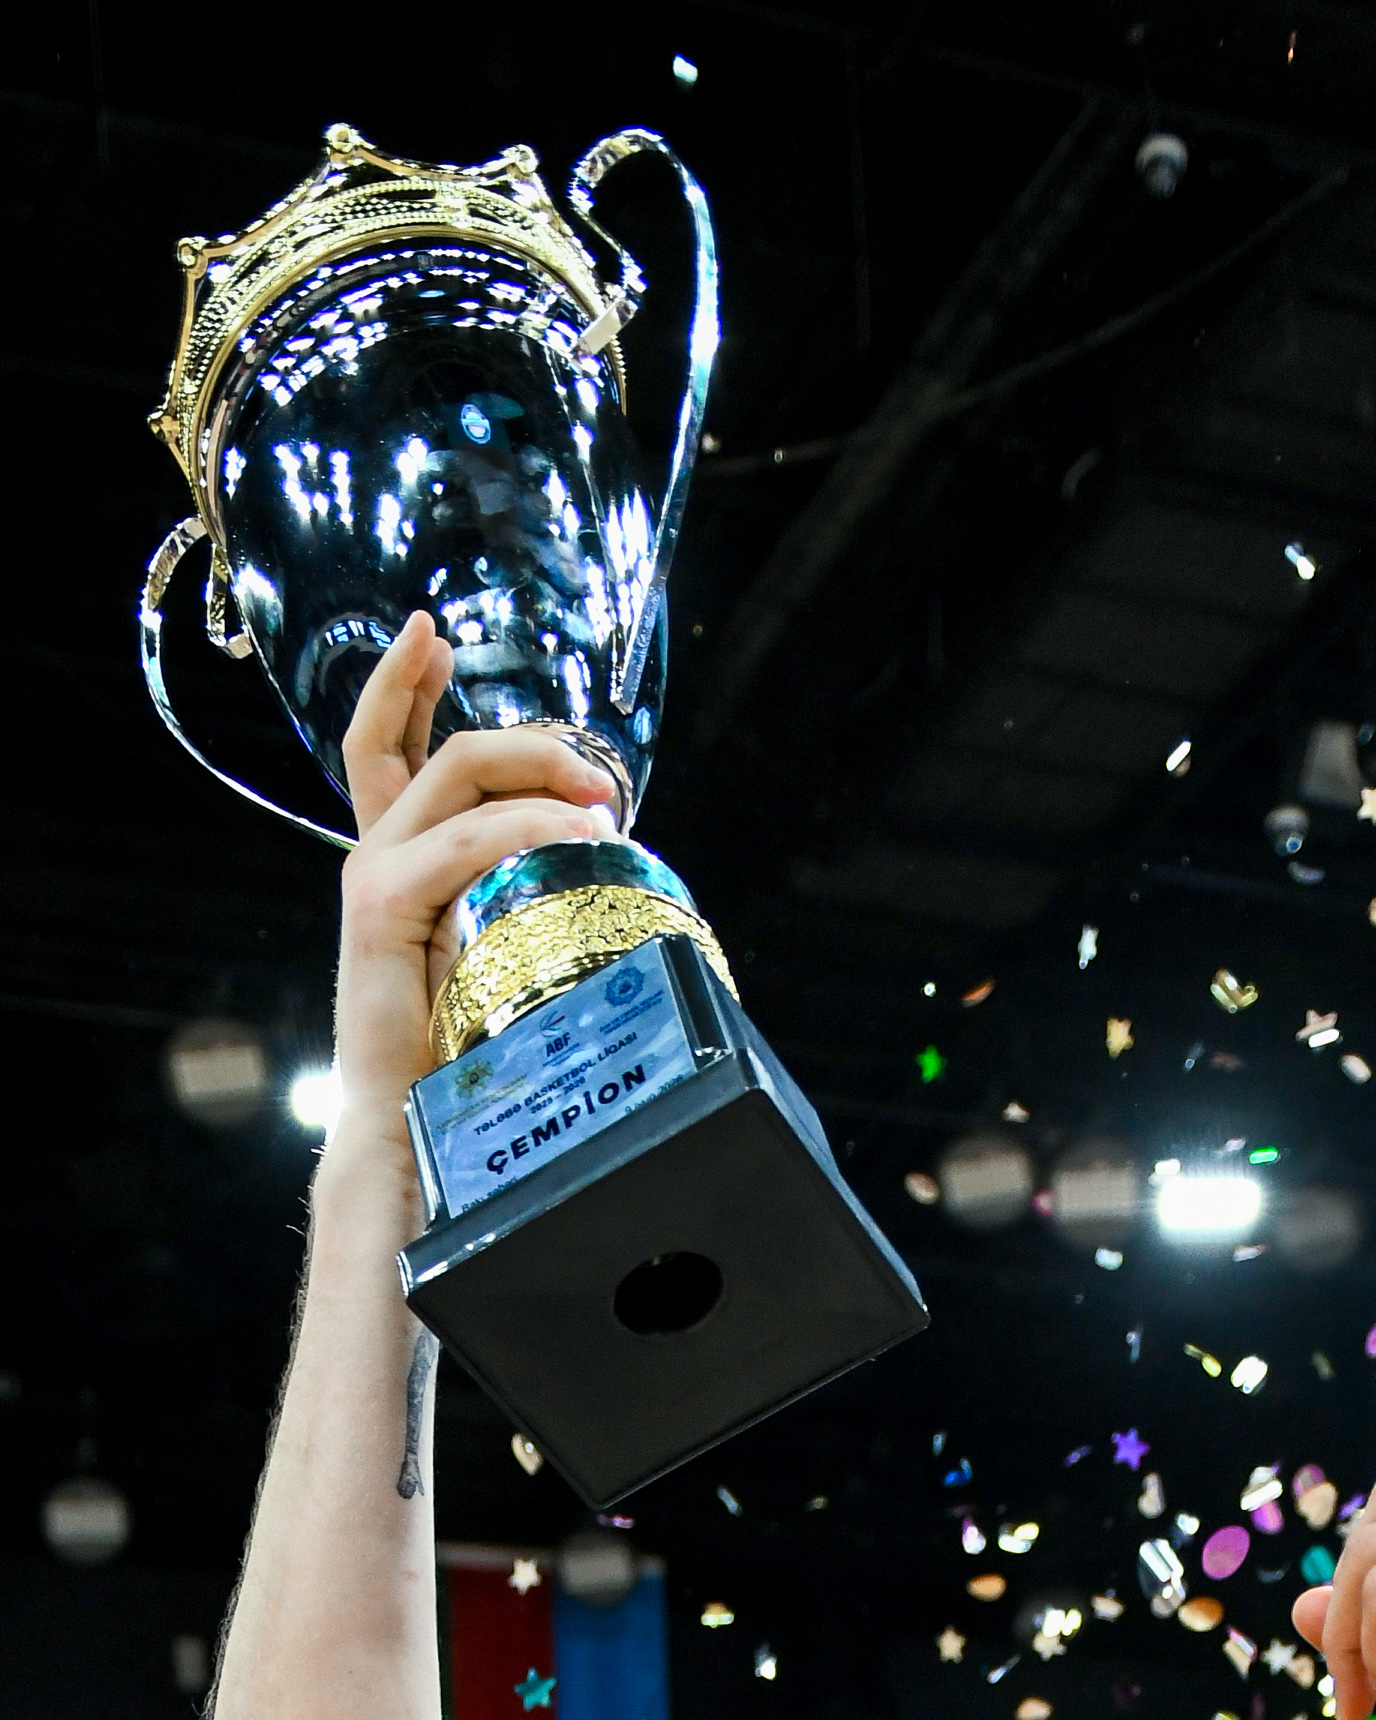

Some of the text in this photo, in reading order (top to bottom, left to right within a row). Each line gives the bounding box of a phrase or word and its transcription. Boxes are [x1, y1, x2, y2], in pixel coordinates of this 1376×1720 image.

[544, 1031, 572, 1057] ABF
[523, 1058, 596, 1107] BASKETBOL
[485, 1063, 646, 1175] ÇEMPİON
